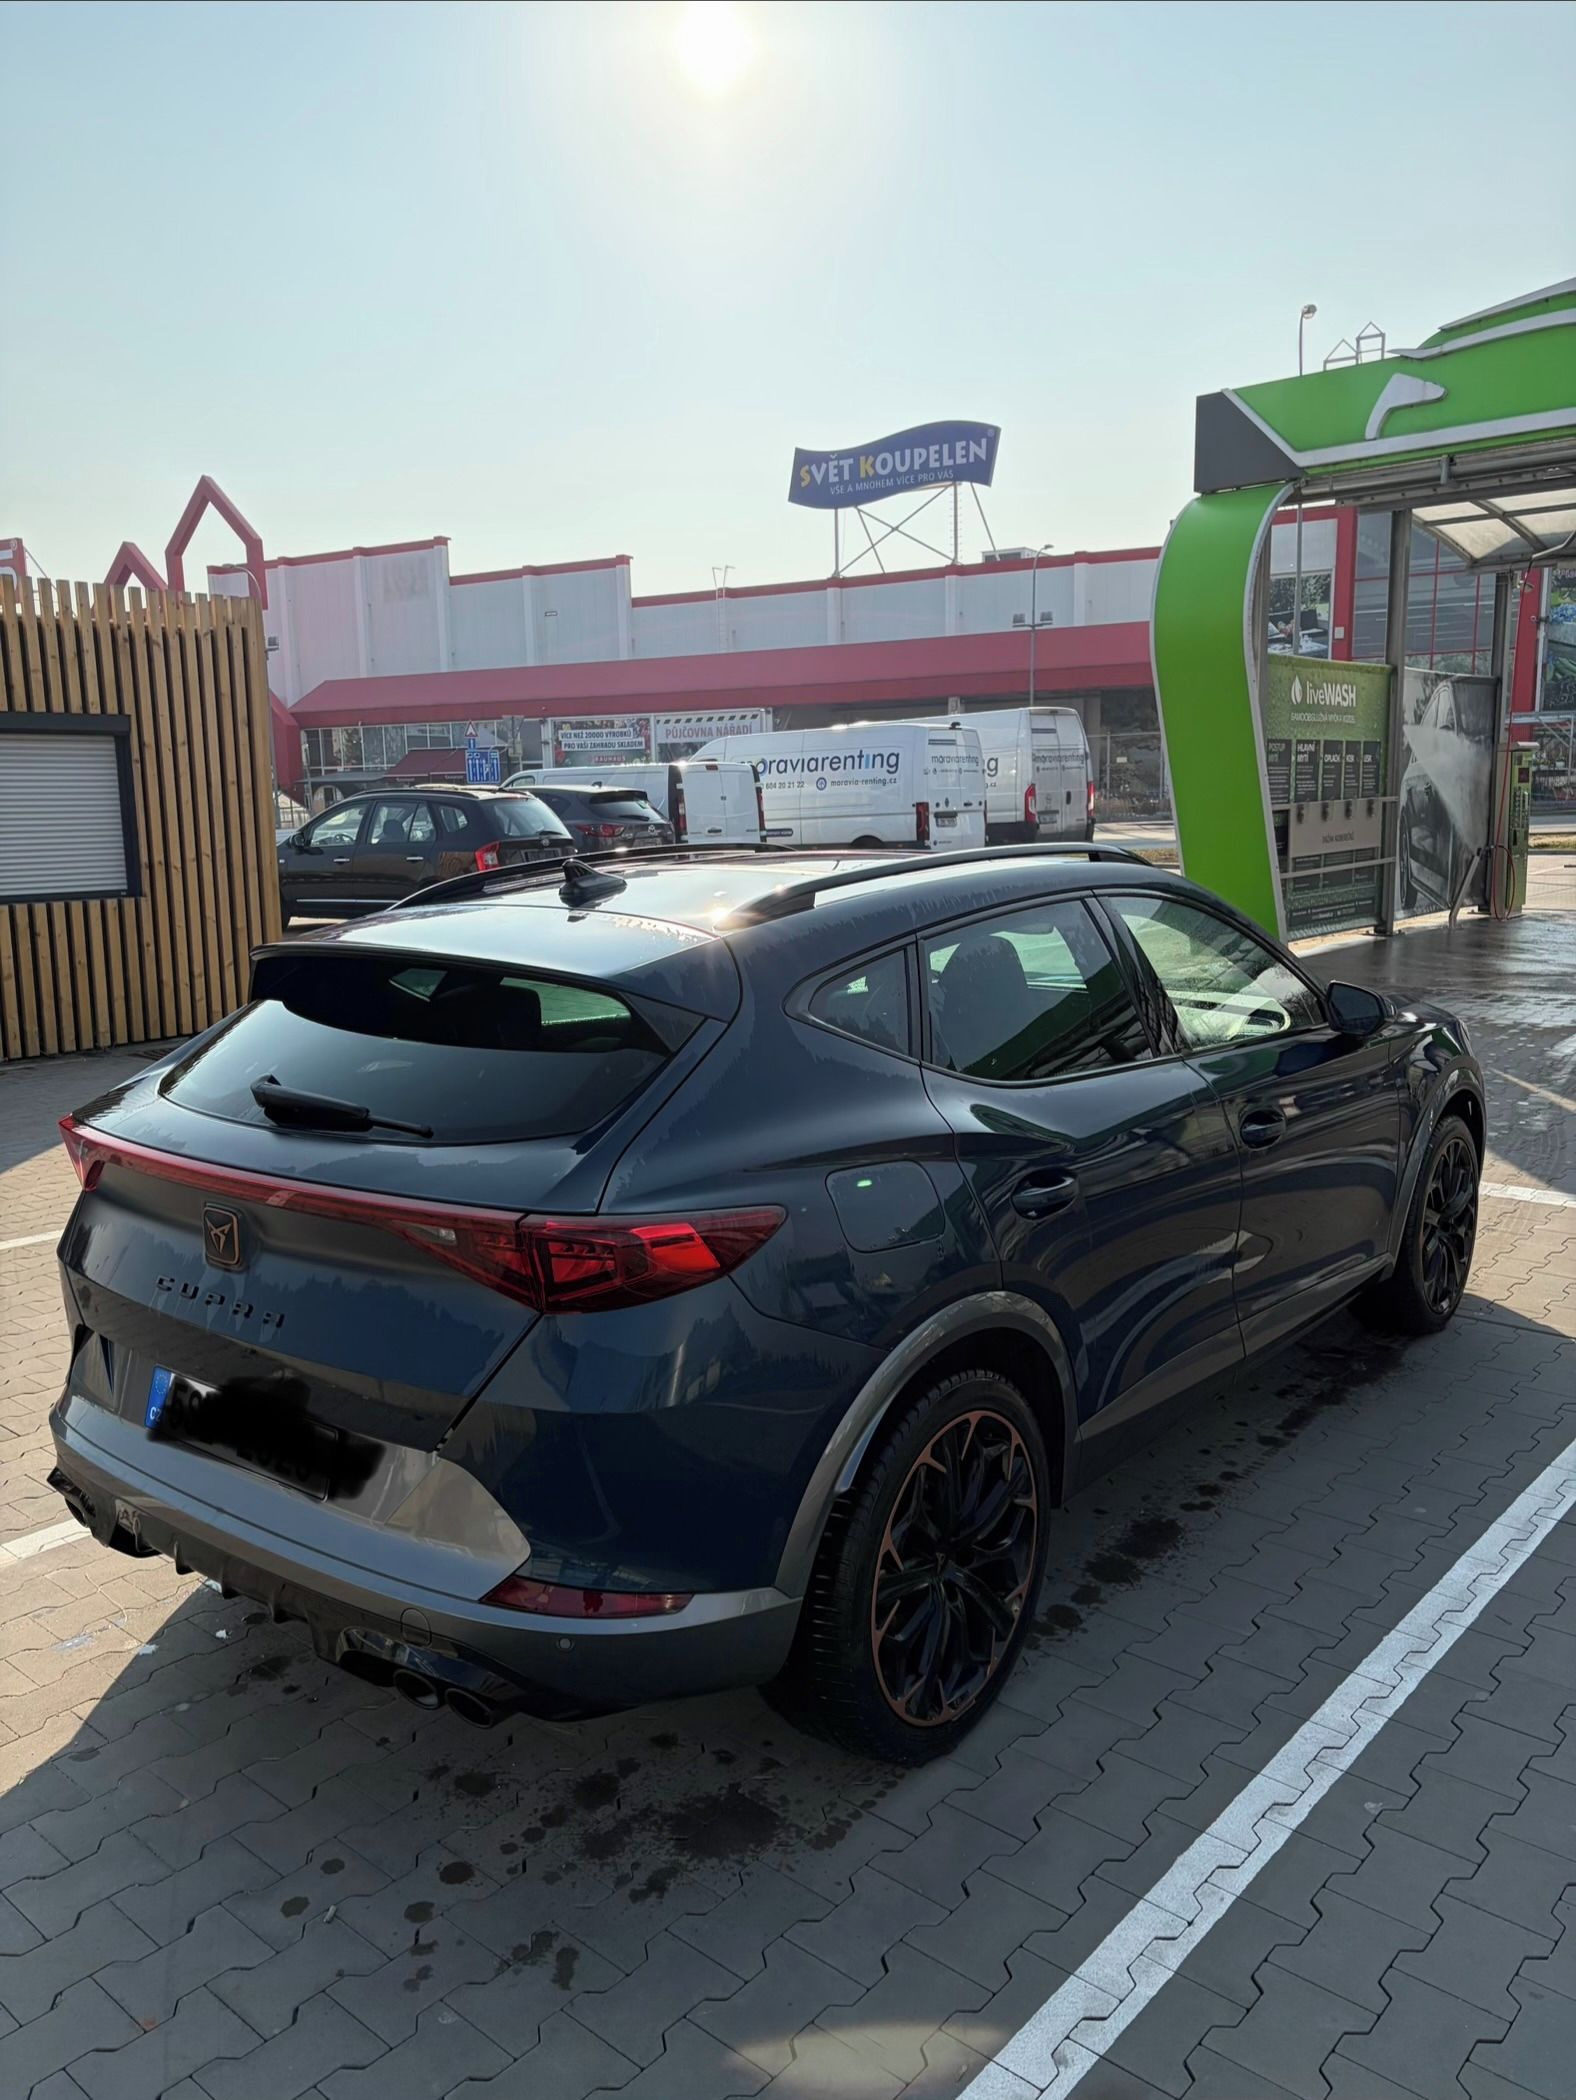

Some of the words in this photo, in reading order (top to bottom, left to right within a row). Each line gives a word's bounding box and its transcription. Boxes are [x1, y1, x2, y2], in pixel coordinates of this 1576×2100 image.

[800, 453, 854, 488] SVĚT
[860, 438, 987, 479] KOUPELEN
[830, 485, 845, 495] VŠE
[847, 484, 853, 492] A
[856, 478, 894, 491] MNOHEM
[896, 474, 914, 485] VÍCE
[918, 472, 935, 482] PRO
[937, 469, 954, 479] VÁS
[1306, 681, 1356, 707] liveWASH
[573, 730, 584, 739] NEŽ
[585, 731, 604, 739] 20000
[665, 726, 713, 739] PŮJČOVNA
[716, 722, 752, 736] NÁŘADÍ
[590, 740, 616, 749] ZAHRADU
[617, 739, 643, 748] SKLADEM
[744, 749, 900, 775] oraviarenting
[778, 781, 786, 789] 20
[155, 1274, 286, 1329] CUPRA
